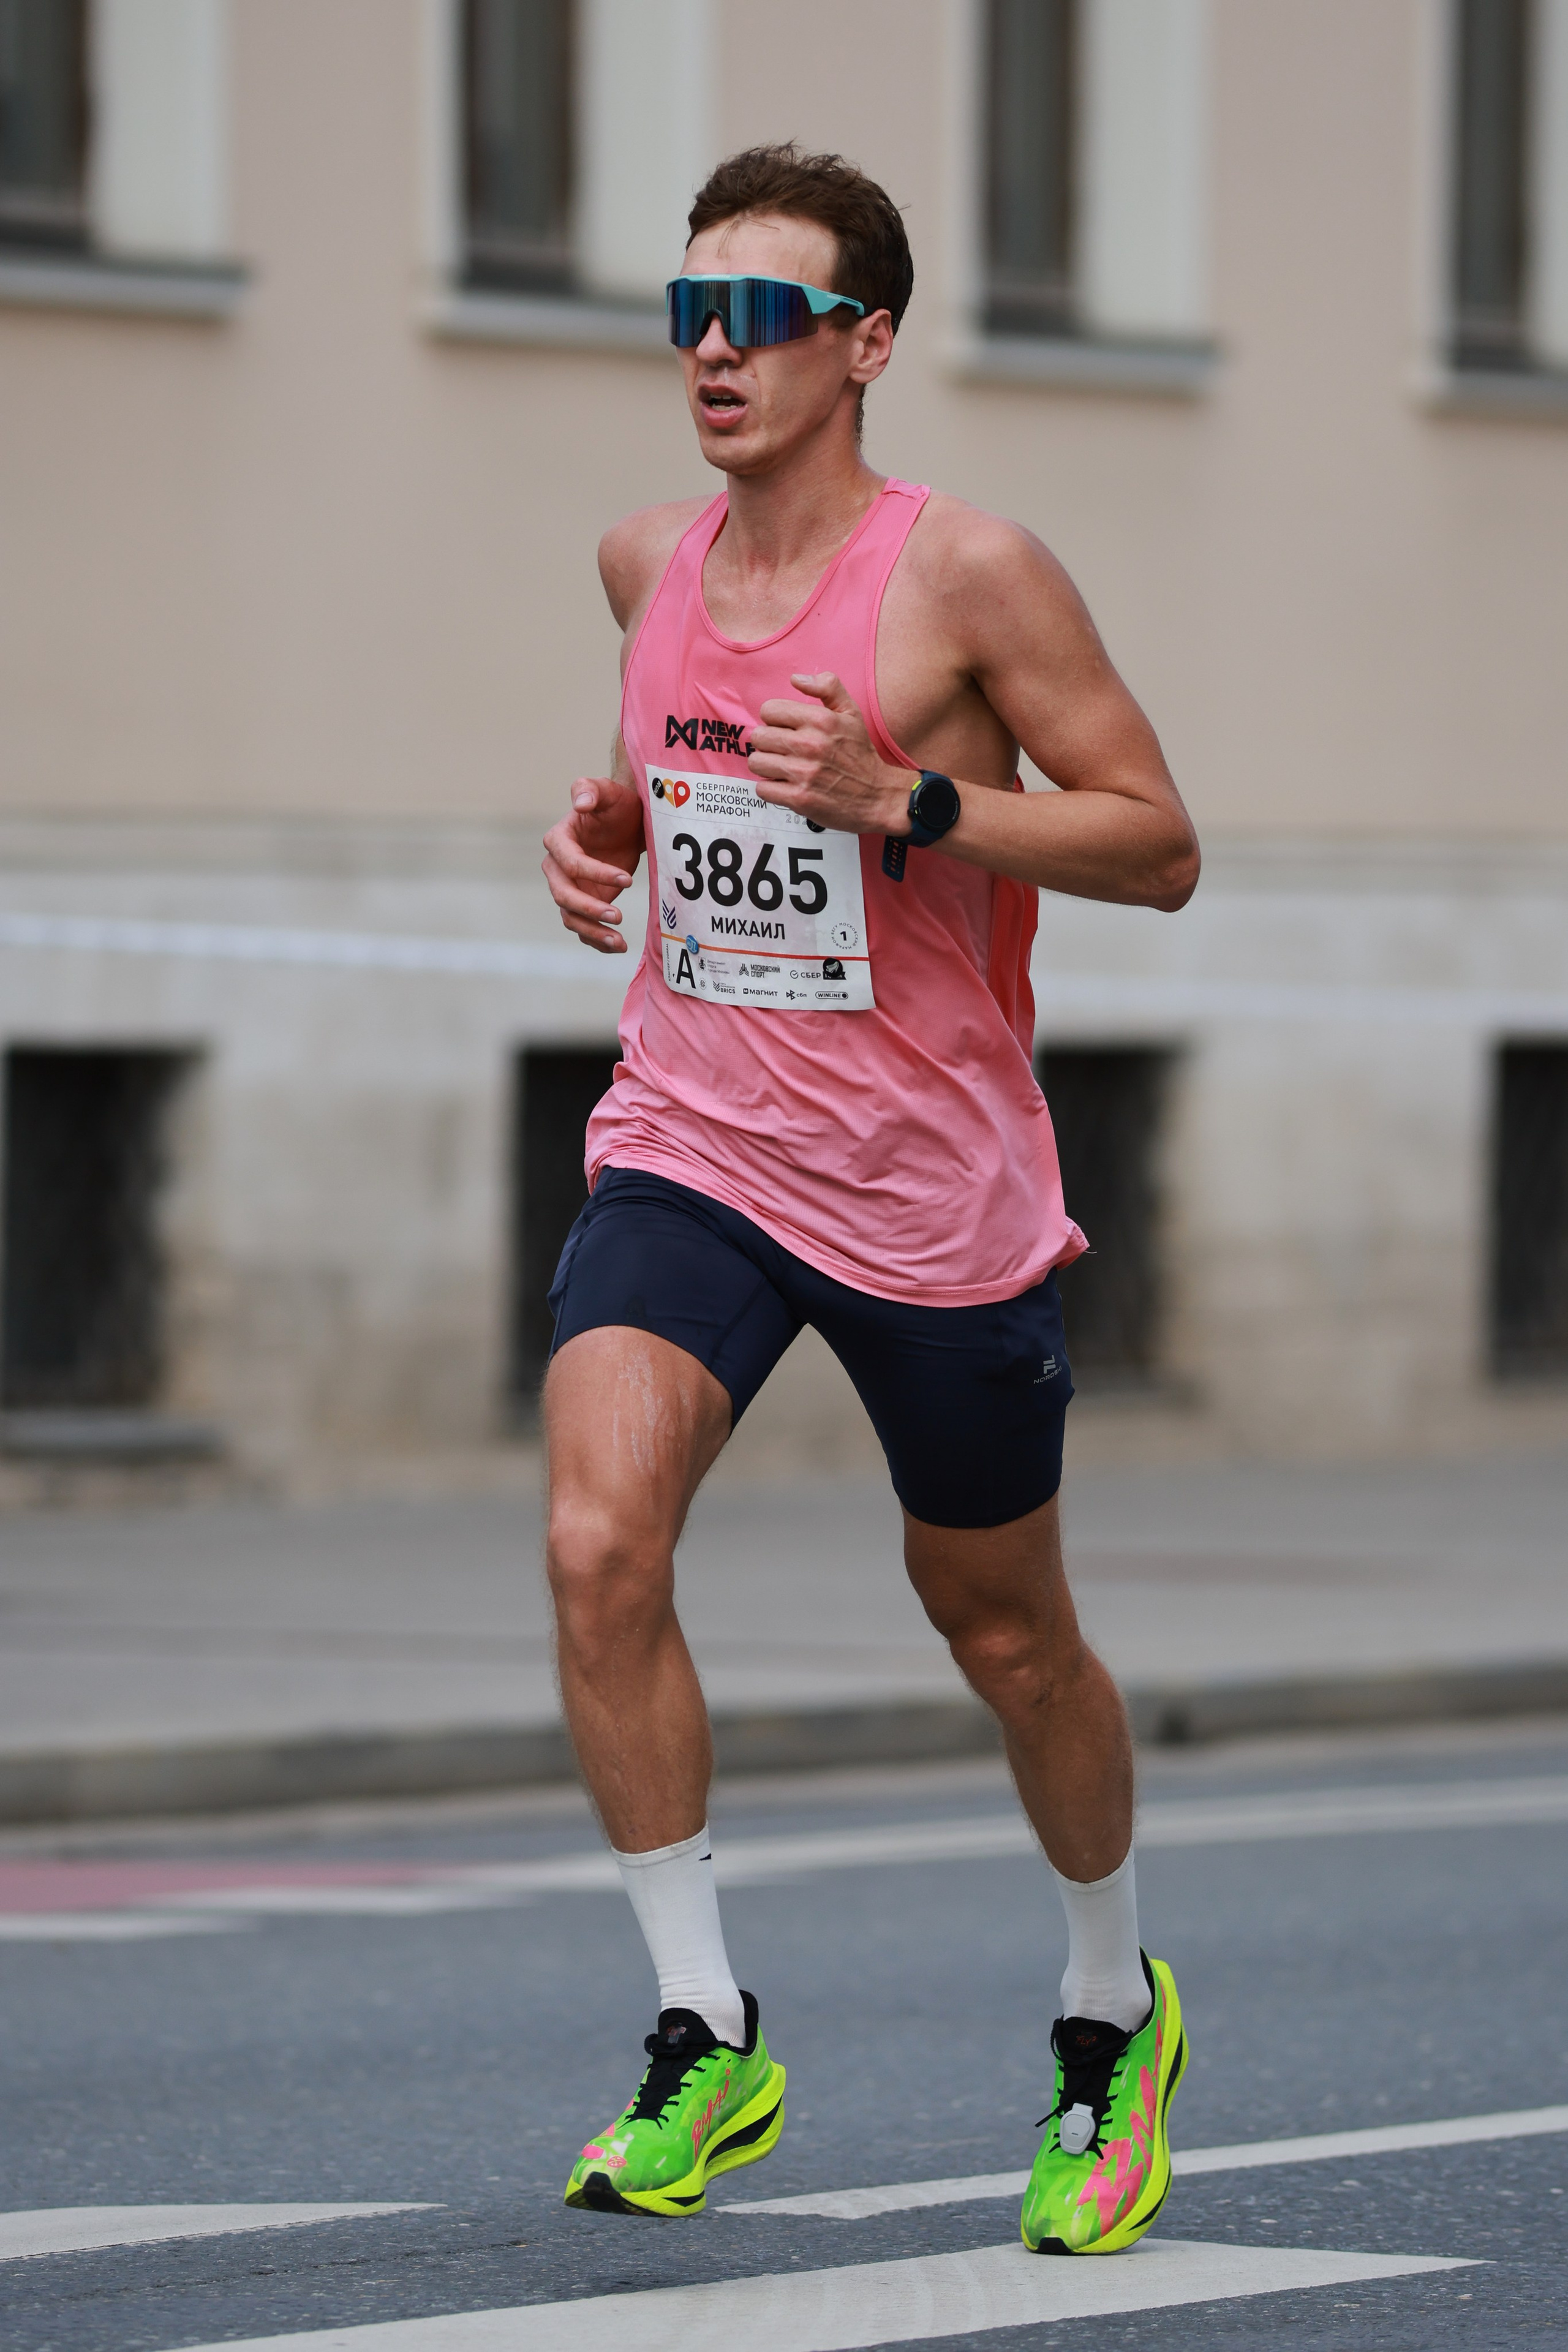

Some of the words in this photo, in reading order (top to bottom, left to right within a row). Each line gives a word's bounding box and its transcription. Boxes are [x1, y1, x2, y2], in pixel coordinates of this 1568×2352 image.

[701, 719, 745, 740] NEW
[696, 782, 748, 795] СБЕРПРАЙМ
[696, 803, 750, 817] МАРАФОН
[673, 833, 827, 915] 3865
[711, 916, 785, 940] МИХАИЛ
[840, 930, 847, 941] 1
[750, 964, 780, 973] МОСКОВСКИЙ
